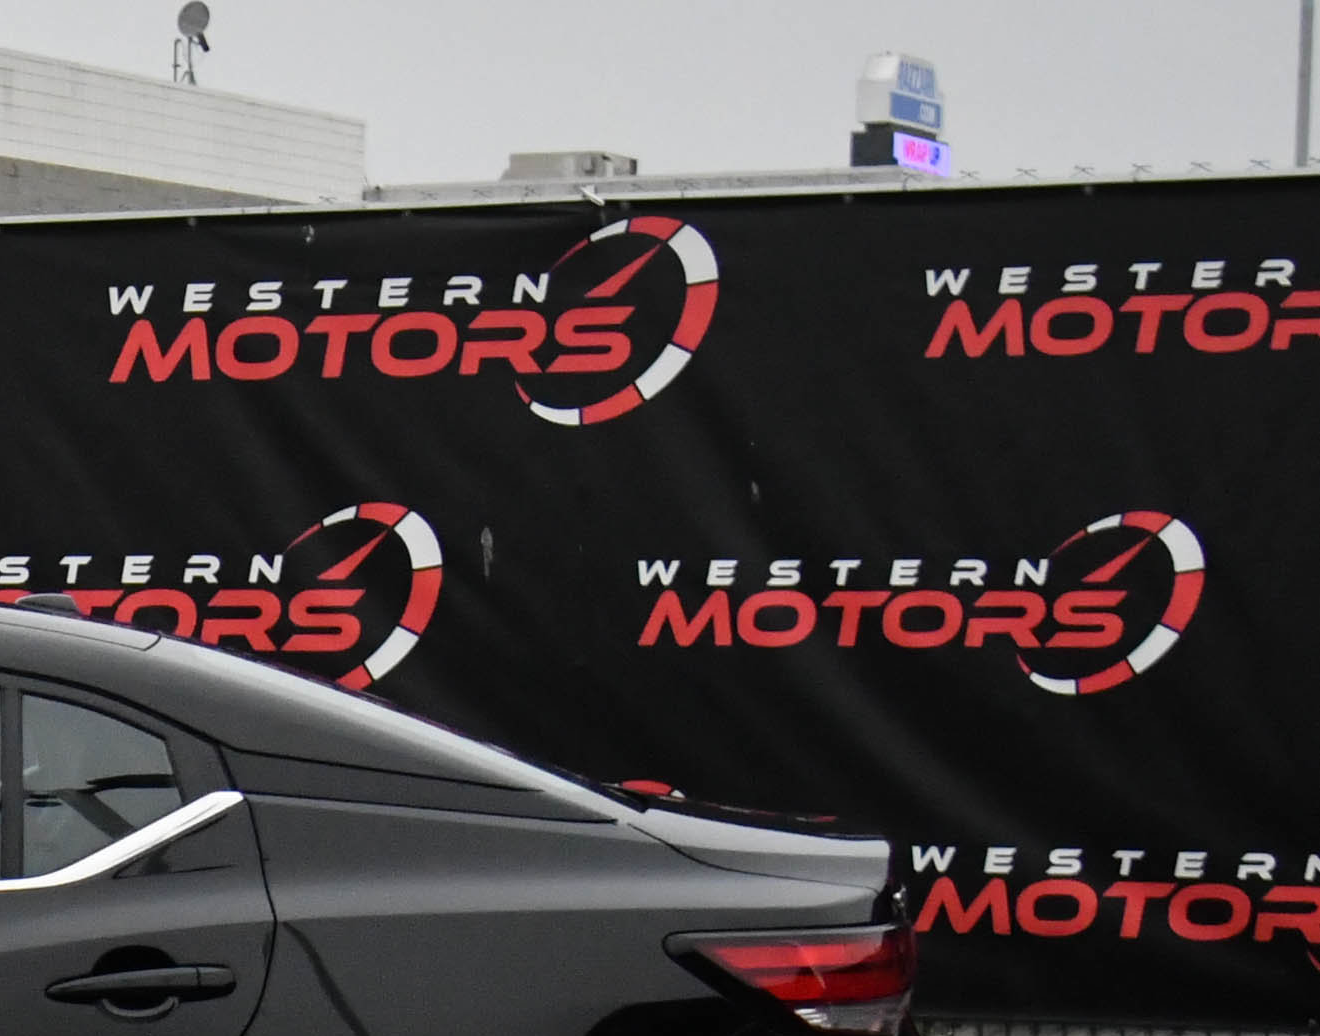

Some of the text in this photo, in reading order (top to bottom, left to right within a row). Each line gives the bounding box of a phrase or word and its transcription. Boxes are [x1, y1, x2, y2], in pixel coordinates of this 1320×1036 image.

[109, 273, 549, 315] WESTERN
[110, 306, 633, 380] MOTORS
[638, 559, 1048, 585] WESTERN
[639, 589, 1124, 648] MOTORS
